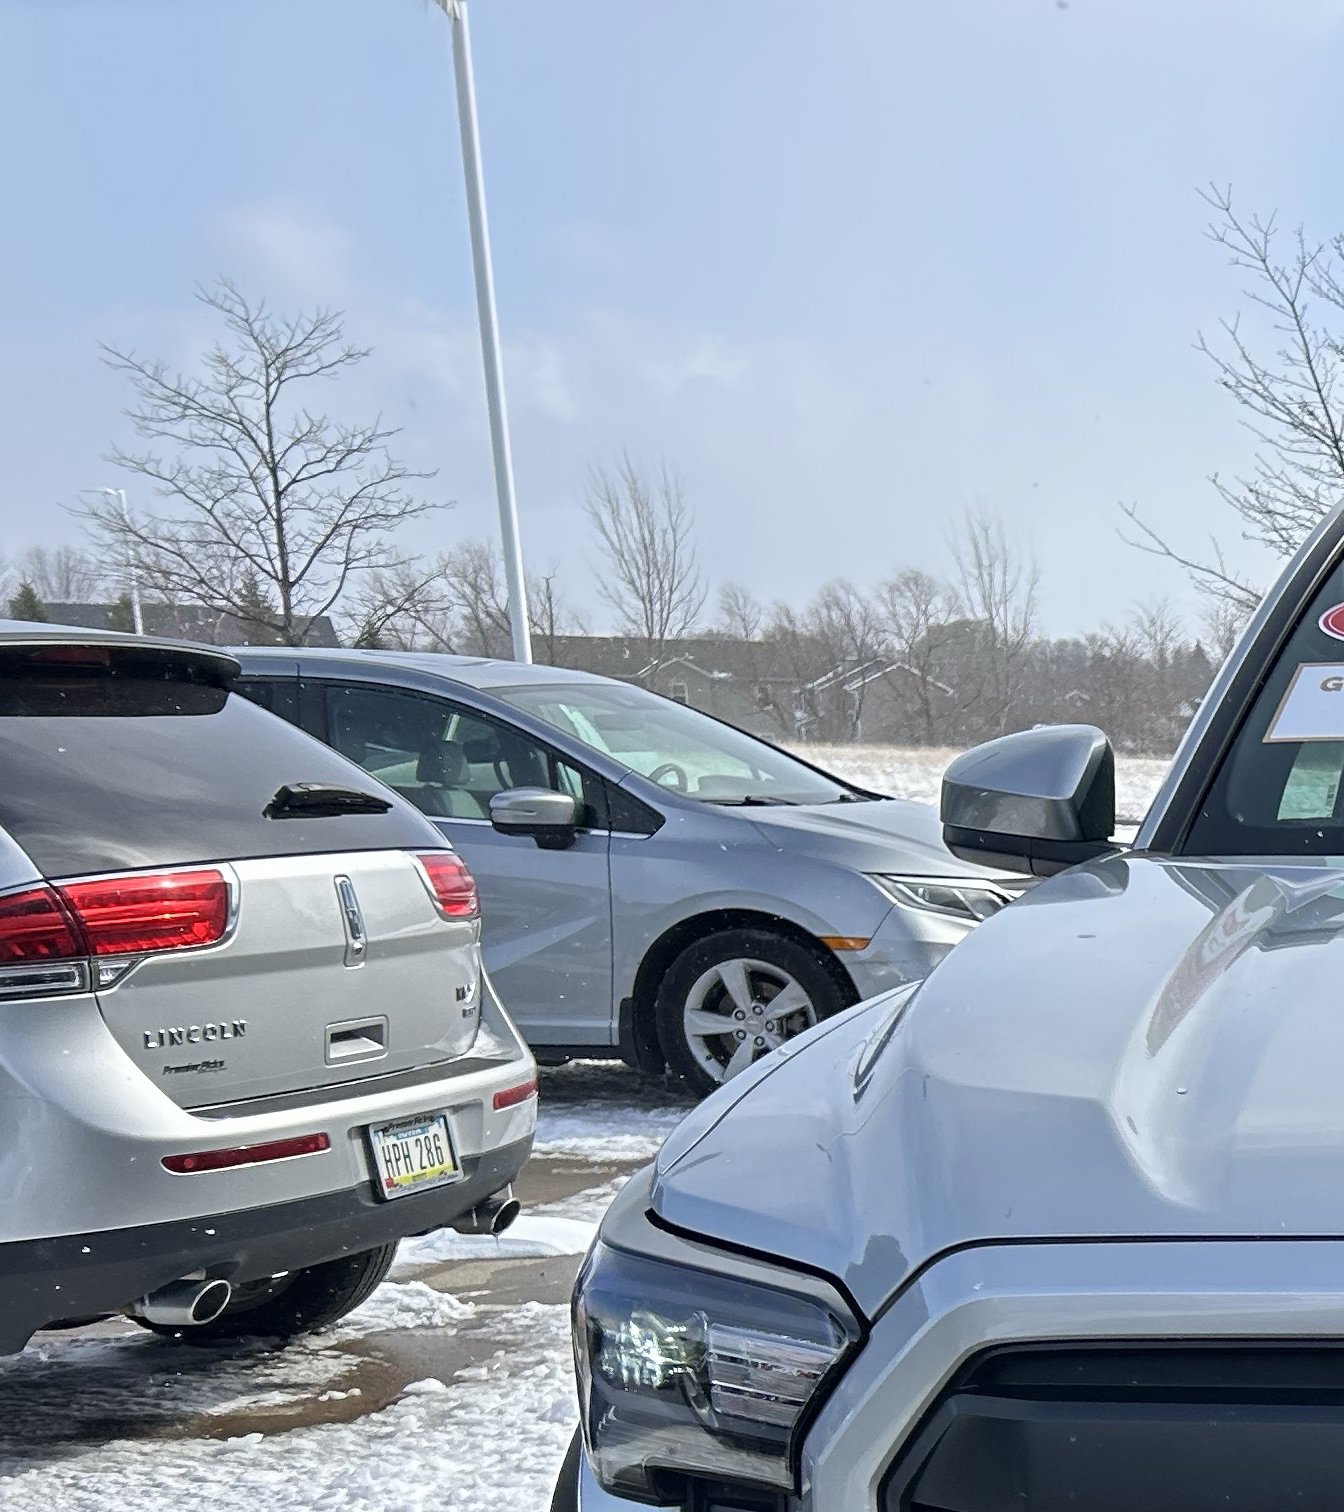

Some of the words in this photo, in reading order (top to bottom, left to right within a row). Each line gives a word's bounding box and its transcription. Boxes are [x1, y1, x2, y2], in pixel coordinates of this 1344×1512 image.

[143, 1019, 249, 1050] LINCOLN
[381, 1140, 415, 1179] HPH
[415, 1133, 445, 1171] 286
